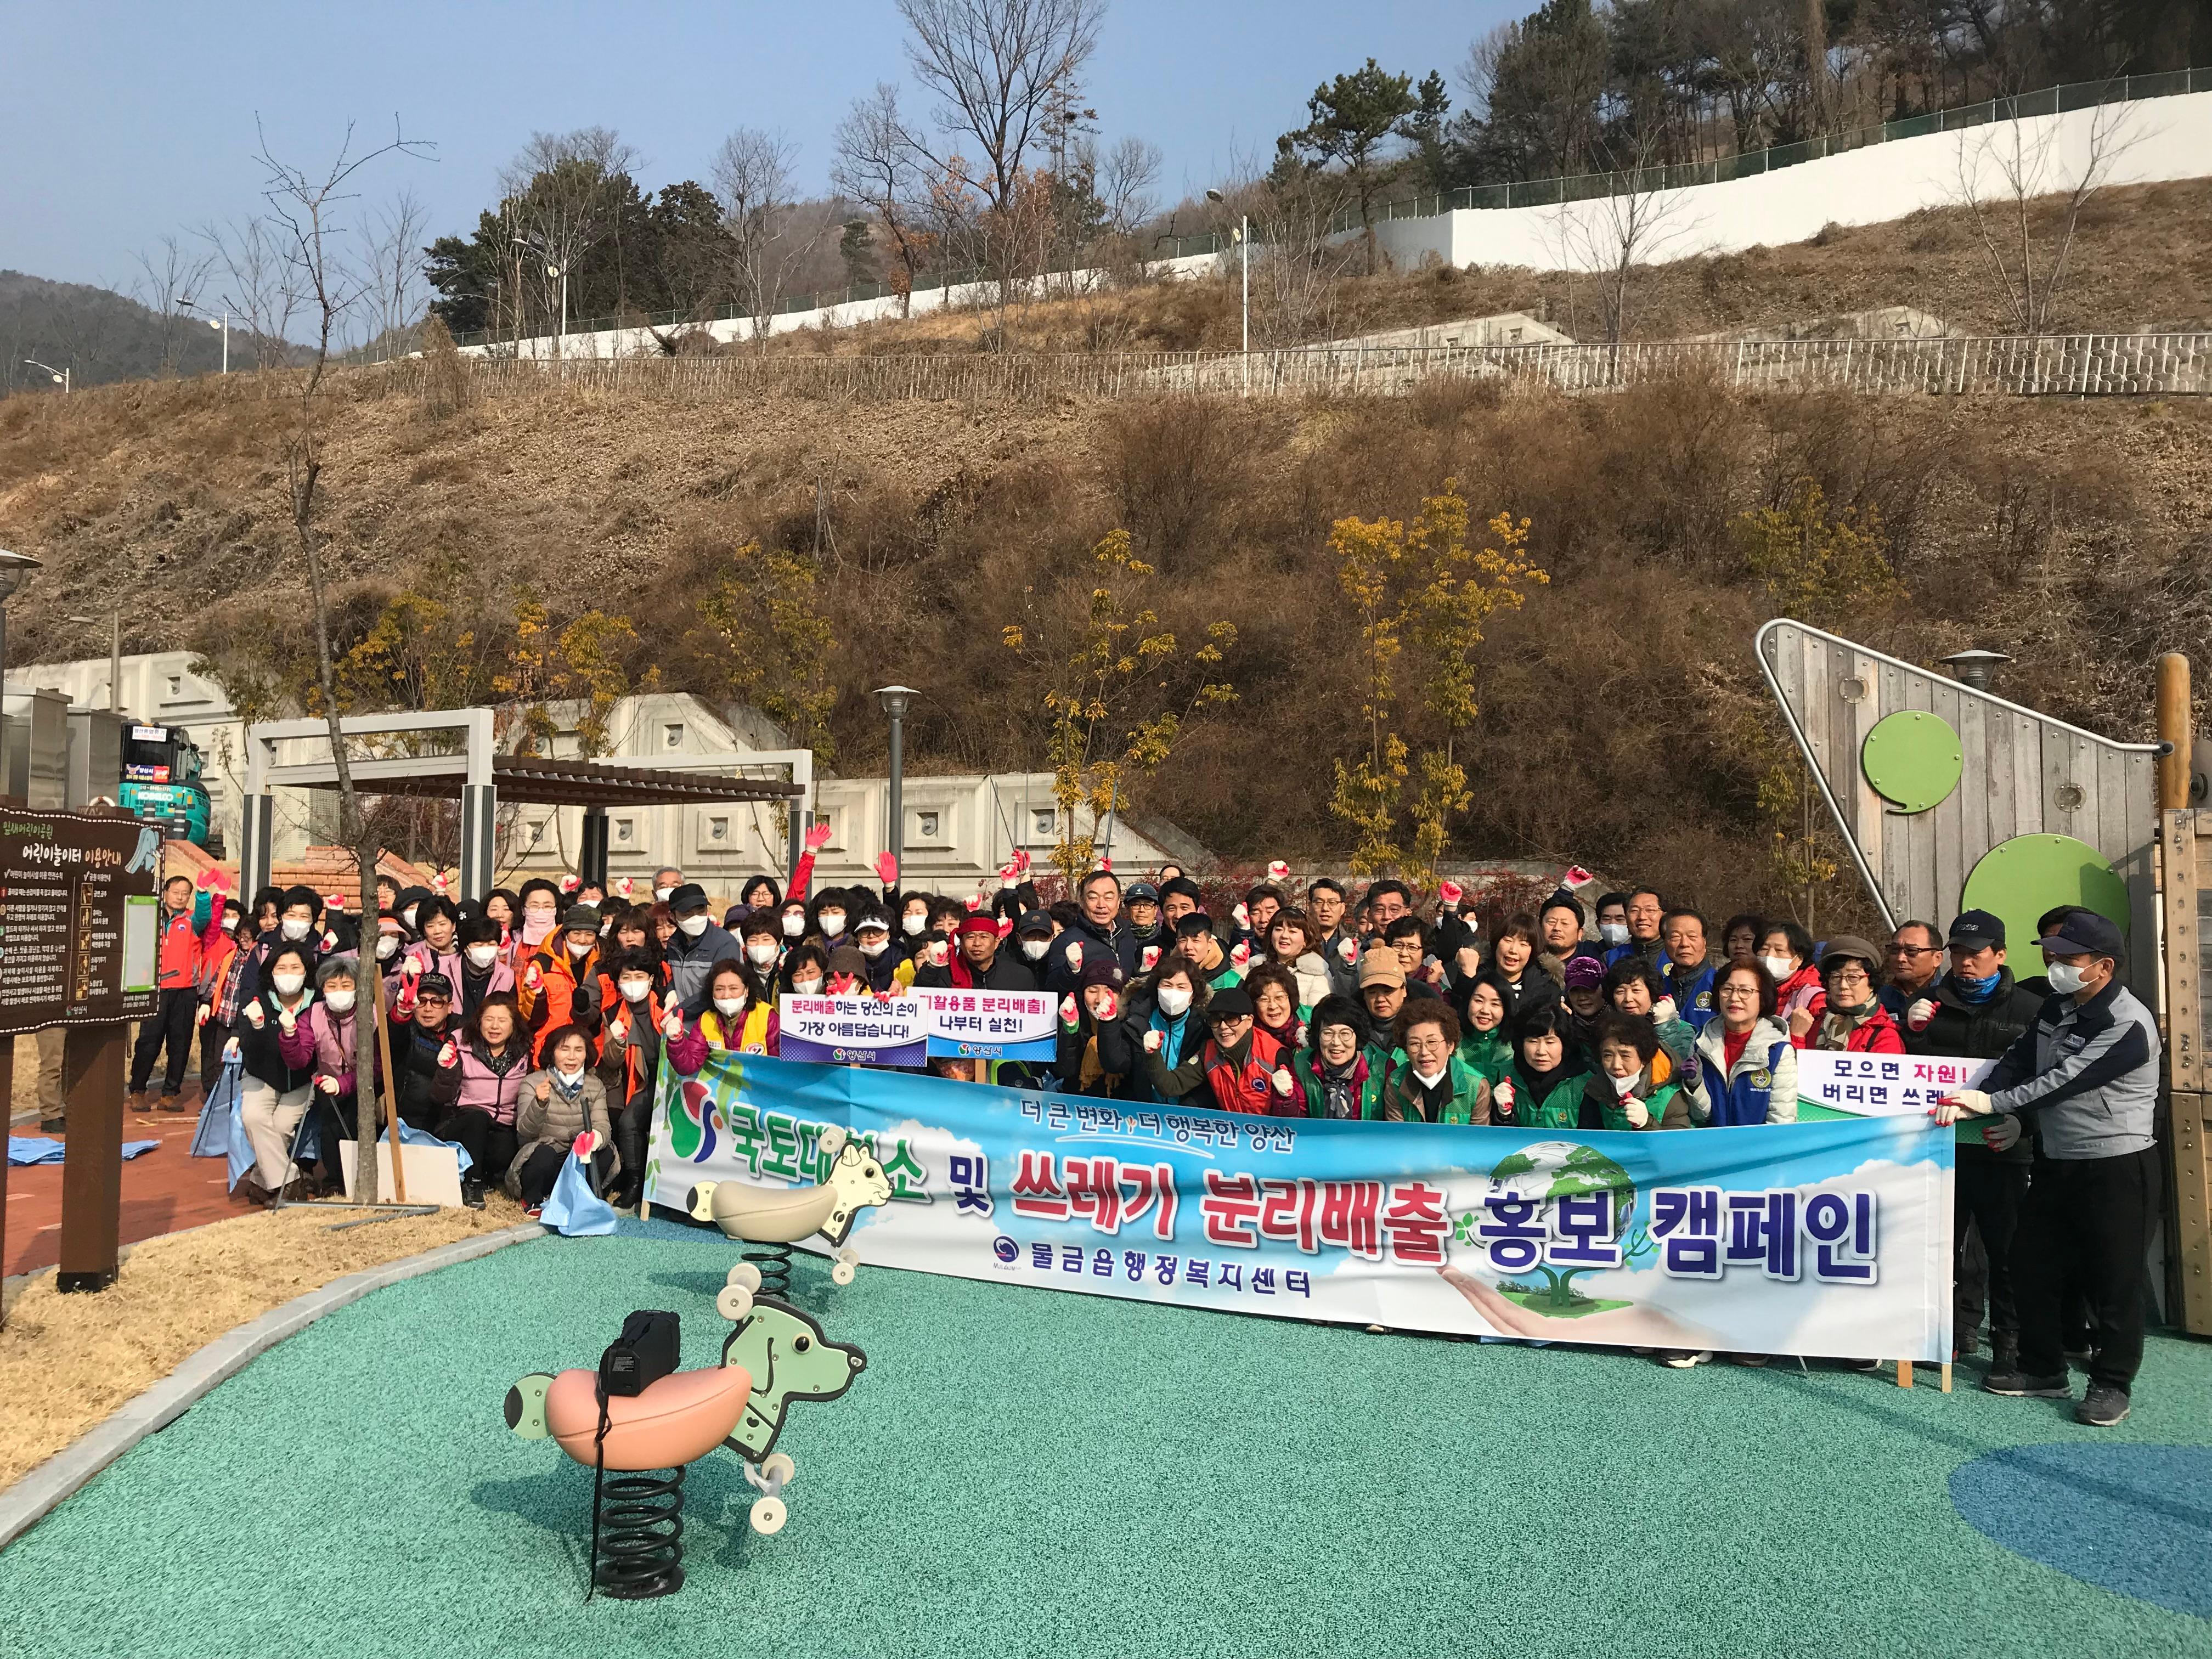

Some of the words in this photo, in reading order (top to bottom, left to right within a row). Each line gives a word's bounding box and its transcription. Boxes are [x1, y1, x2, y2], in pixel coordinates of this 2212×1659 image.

[22, 843, 81, 867] 어린이놀이터
[85, 847, 121, 868] 이용안내
[792, 1000, 857, 1016] 분리배출하는
[861, 1001, 893, 1017] 당신의
[896, 1002, 917, 1018] 손이
[983, 997, 1046, 1015] 분리배출!
[799, 1021, 825, 1036] 가장
[829, 1022, 909, 1039] 아름답습니다!
[940, 1015, 982, 1032] 나부터
[989, 1017, 1023, 1033] 실천!
[847, 1050, 876, 1062] 양산시
[973, 1045, 1002, 1057] 양산시
[1834, 1059, 1899, 1081] 모으면
[1914, 1064, 1967, 1084] 자원!
[1823, 1084, 1887, 1105] 버리면
[1902, 1089, 1945, 1106] 쓰레
[1021, 1099, 1041, 1124] 더
[1048, 1103, 1071, 1129] 큰
[1076, 1105, 1121, 1132] 변화
[1139, 1111, 1161, 1135] 더
[1166, 1114, 1239, 1147] 행복한
[1245, 1124, 1295, 1152] 양산
[731, 1104, 927, 1200] 국토대소
[950, 1155, 989, 1211] 및
[1012, 1152, 1173, 1236] 쓰레기
[1204, 1173, 1448, 1262] 분리배출
[1480, 1190, 1618, 1267] 홍보
[1652, 1191, 1871, 1279] 캠페인
[1031, 1242, 1311, 1298] 물금읍행정복지센터
